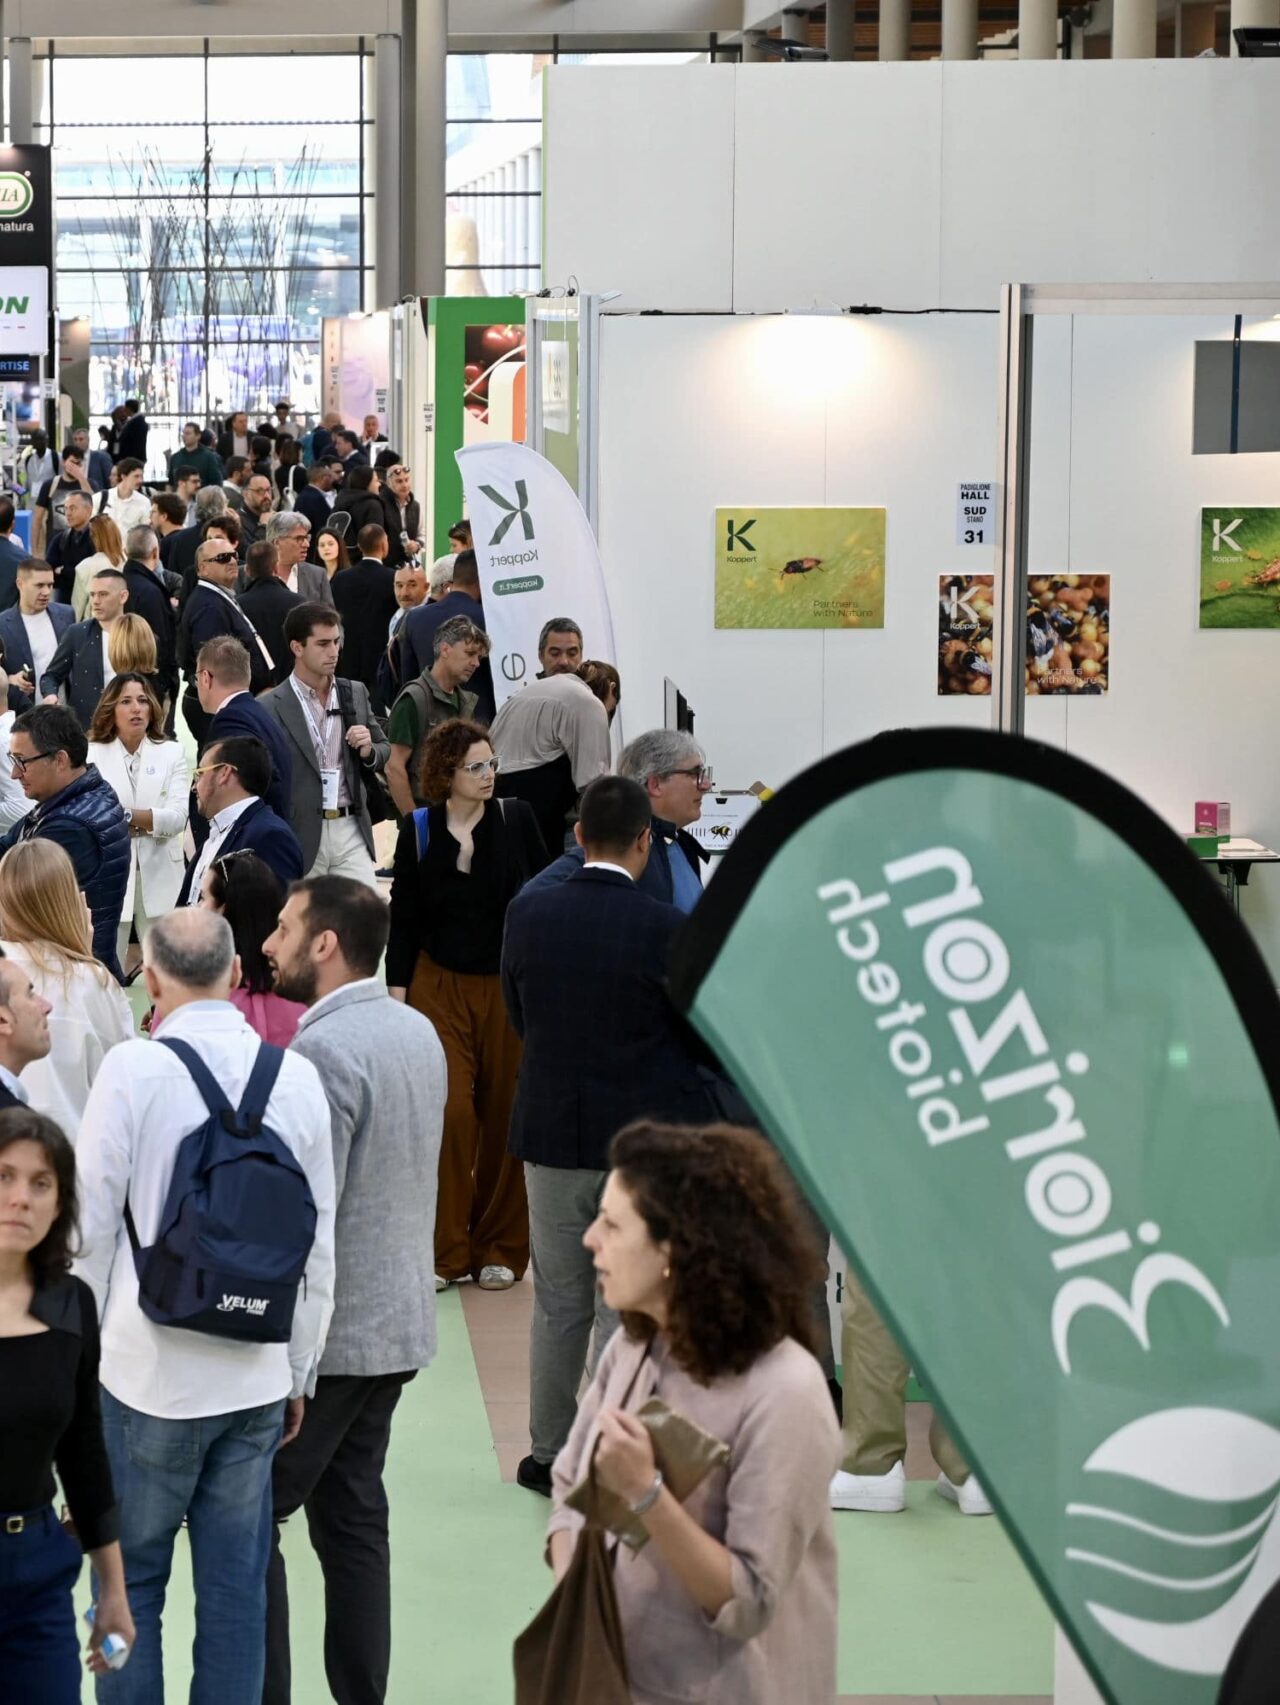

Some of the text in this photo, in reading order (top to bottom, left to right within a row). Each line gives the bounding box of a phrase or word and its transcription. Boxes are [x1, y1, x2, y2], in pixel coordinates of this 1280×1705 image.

[961, 492, 990, 500] HALL
[964, 506, 987, 515] SUD
[964, 530, 984, 544] 31
[726, 555, 757, 563] Koppert
[949, 622, 980, 631] Koppert
[222, 1293, 266, 1312] VELUM
